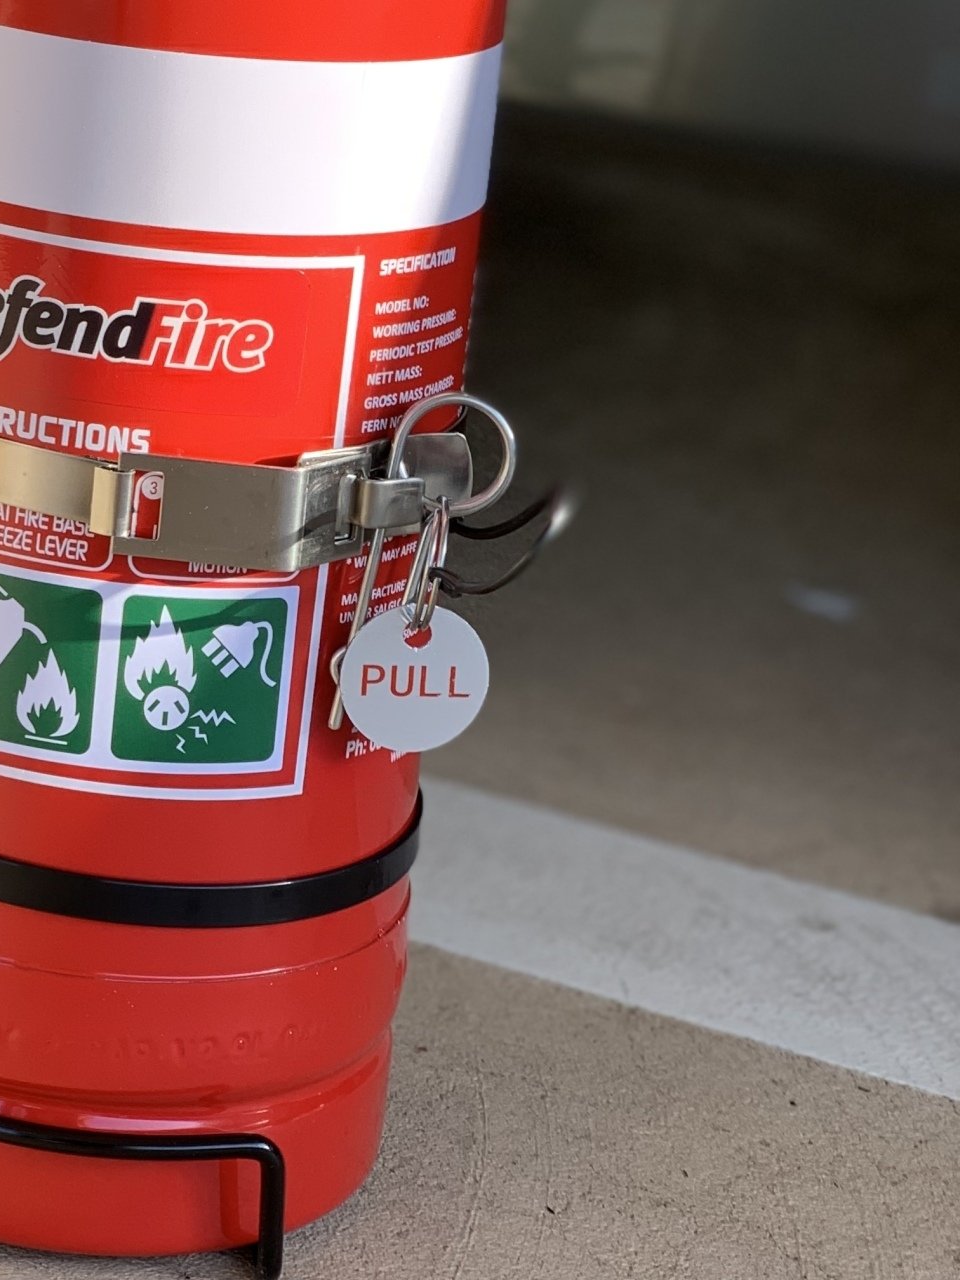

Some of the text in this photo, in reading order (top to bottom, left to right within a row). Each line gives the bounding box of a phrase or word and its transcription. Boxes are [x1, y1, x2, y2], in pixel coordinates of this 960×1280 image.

[379, 247, 456, 276] SPECIFICATION
[375, 296, 430, 315] MODEL NO:
[372, 320, 421, 339] WORKING
[369, 343, 415, 363] PERIODIC
[416, 339, 435, 355] TEST
[367, 365, 422, 386] NETT MASS:
[364, 393, 397, 410] GROSS
[399, 387, 423, 404] MASS
[362, 418, 388, 433] FERN
[36, 532, 89, 561] LEVER
[381, 547, 401, 563] MAY
[360, 664, 471, 698] PULL
[345, 739, 368, 759] Ph:
